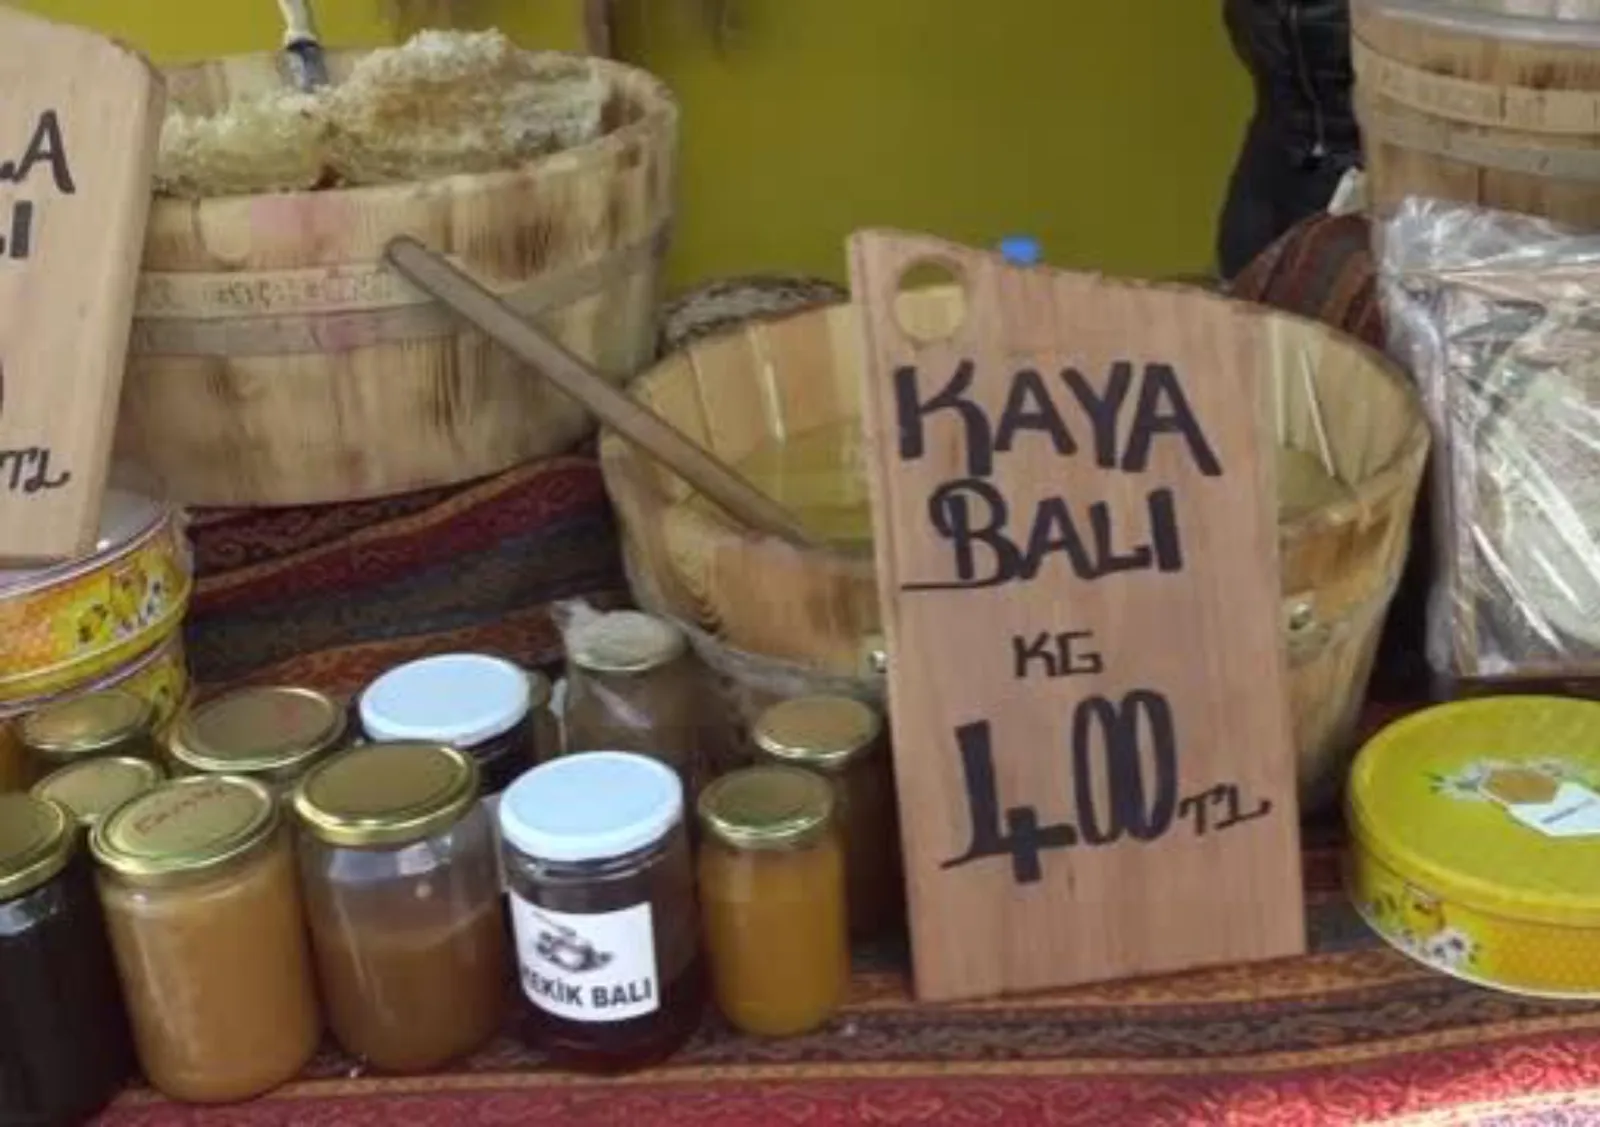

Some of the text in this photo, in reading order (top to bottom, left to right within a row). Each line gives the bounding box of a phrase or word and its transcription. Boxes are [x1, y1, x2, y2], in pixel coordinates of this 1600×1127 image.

[0, 110, 76, 194] A
[0, 200, 33, 259] I
[893, 358, 1222, 477] KAYA
[901, 477, 1183, 590] BALI
[1012, 630, 1104, 679] KG
[938, 687, 1274, 884] 400 TL
[590, 977, 653, 1010] BALI
